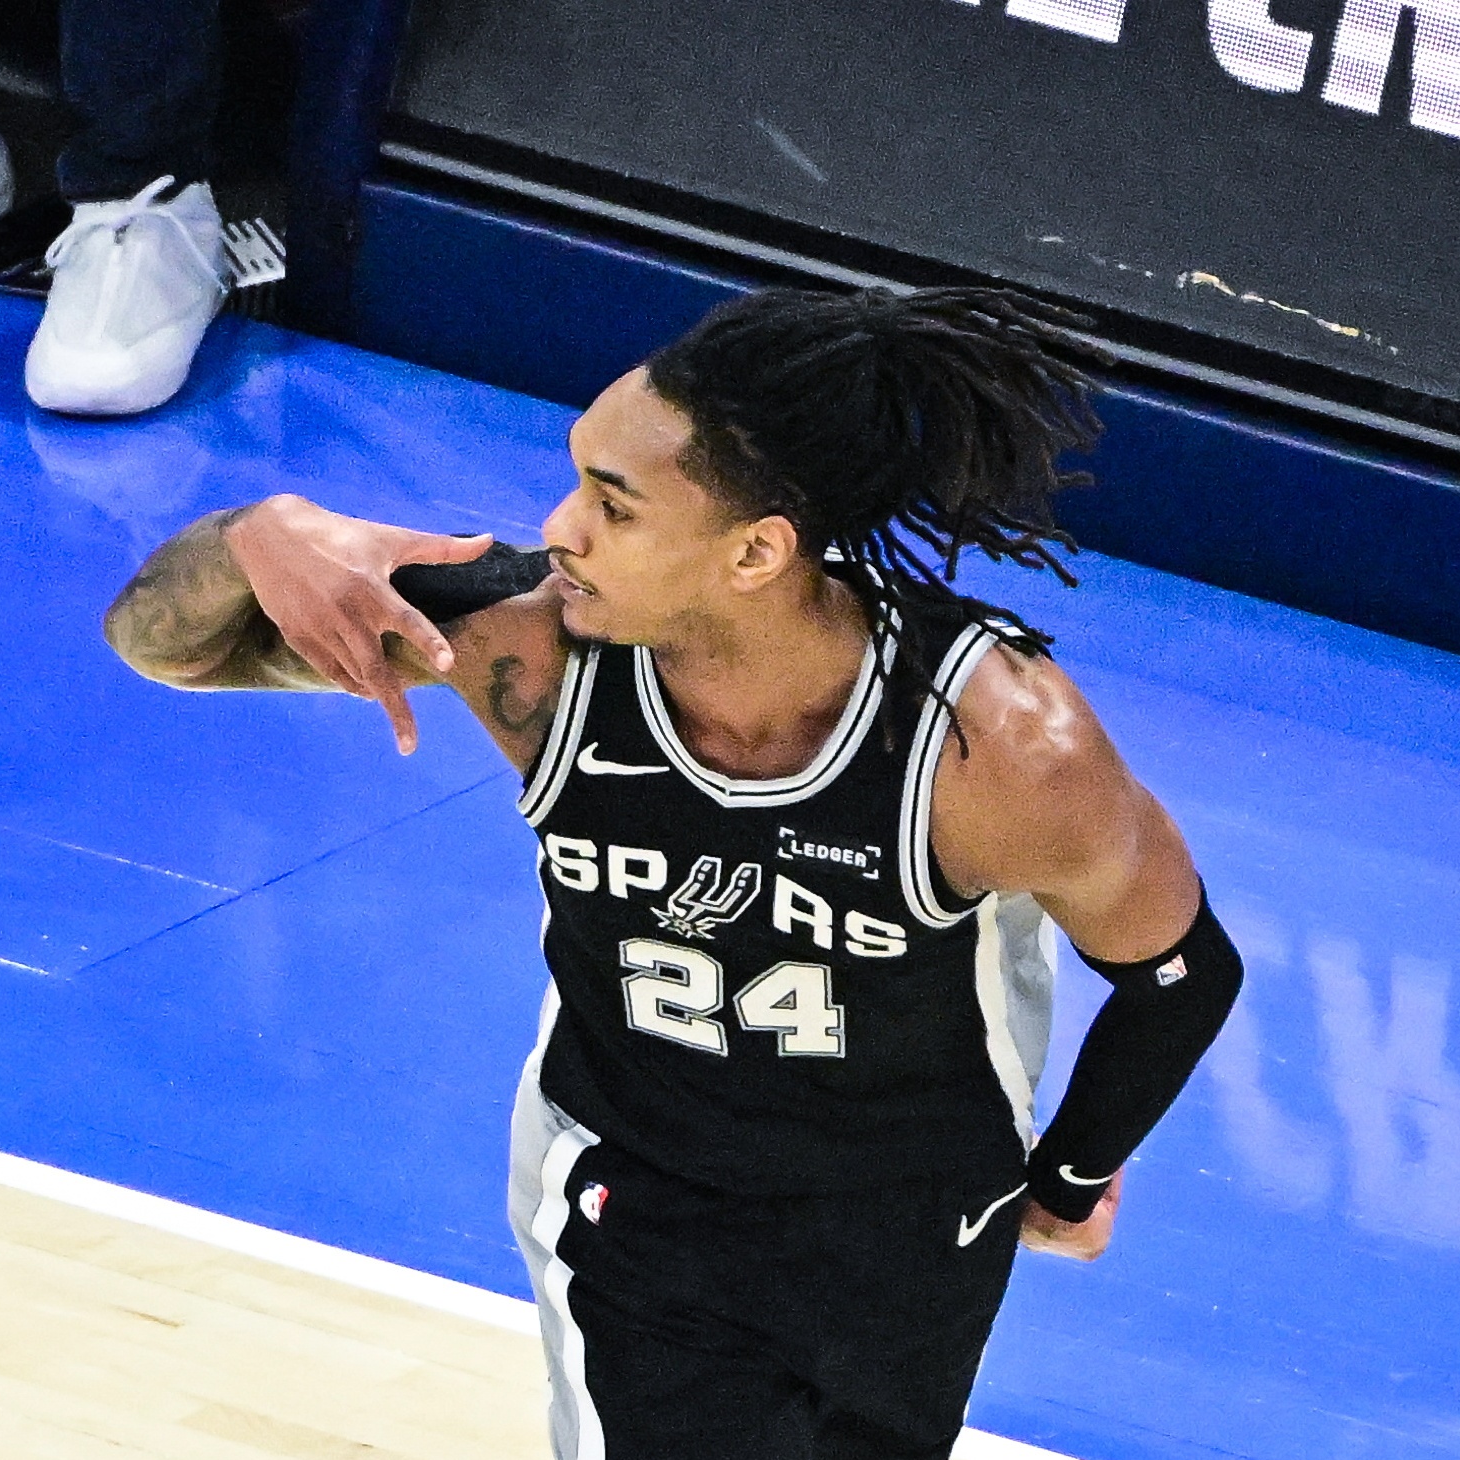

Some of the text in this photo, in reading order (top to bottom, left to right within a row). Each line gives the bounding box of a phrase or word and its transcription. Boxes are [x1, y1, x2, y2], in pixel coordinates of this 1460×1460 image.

[544, 832, 909, 959] SPURS
[789, 838, 869, 868] LEDGER
[619, 937, 846, 1058] 24
